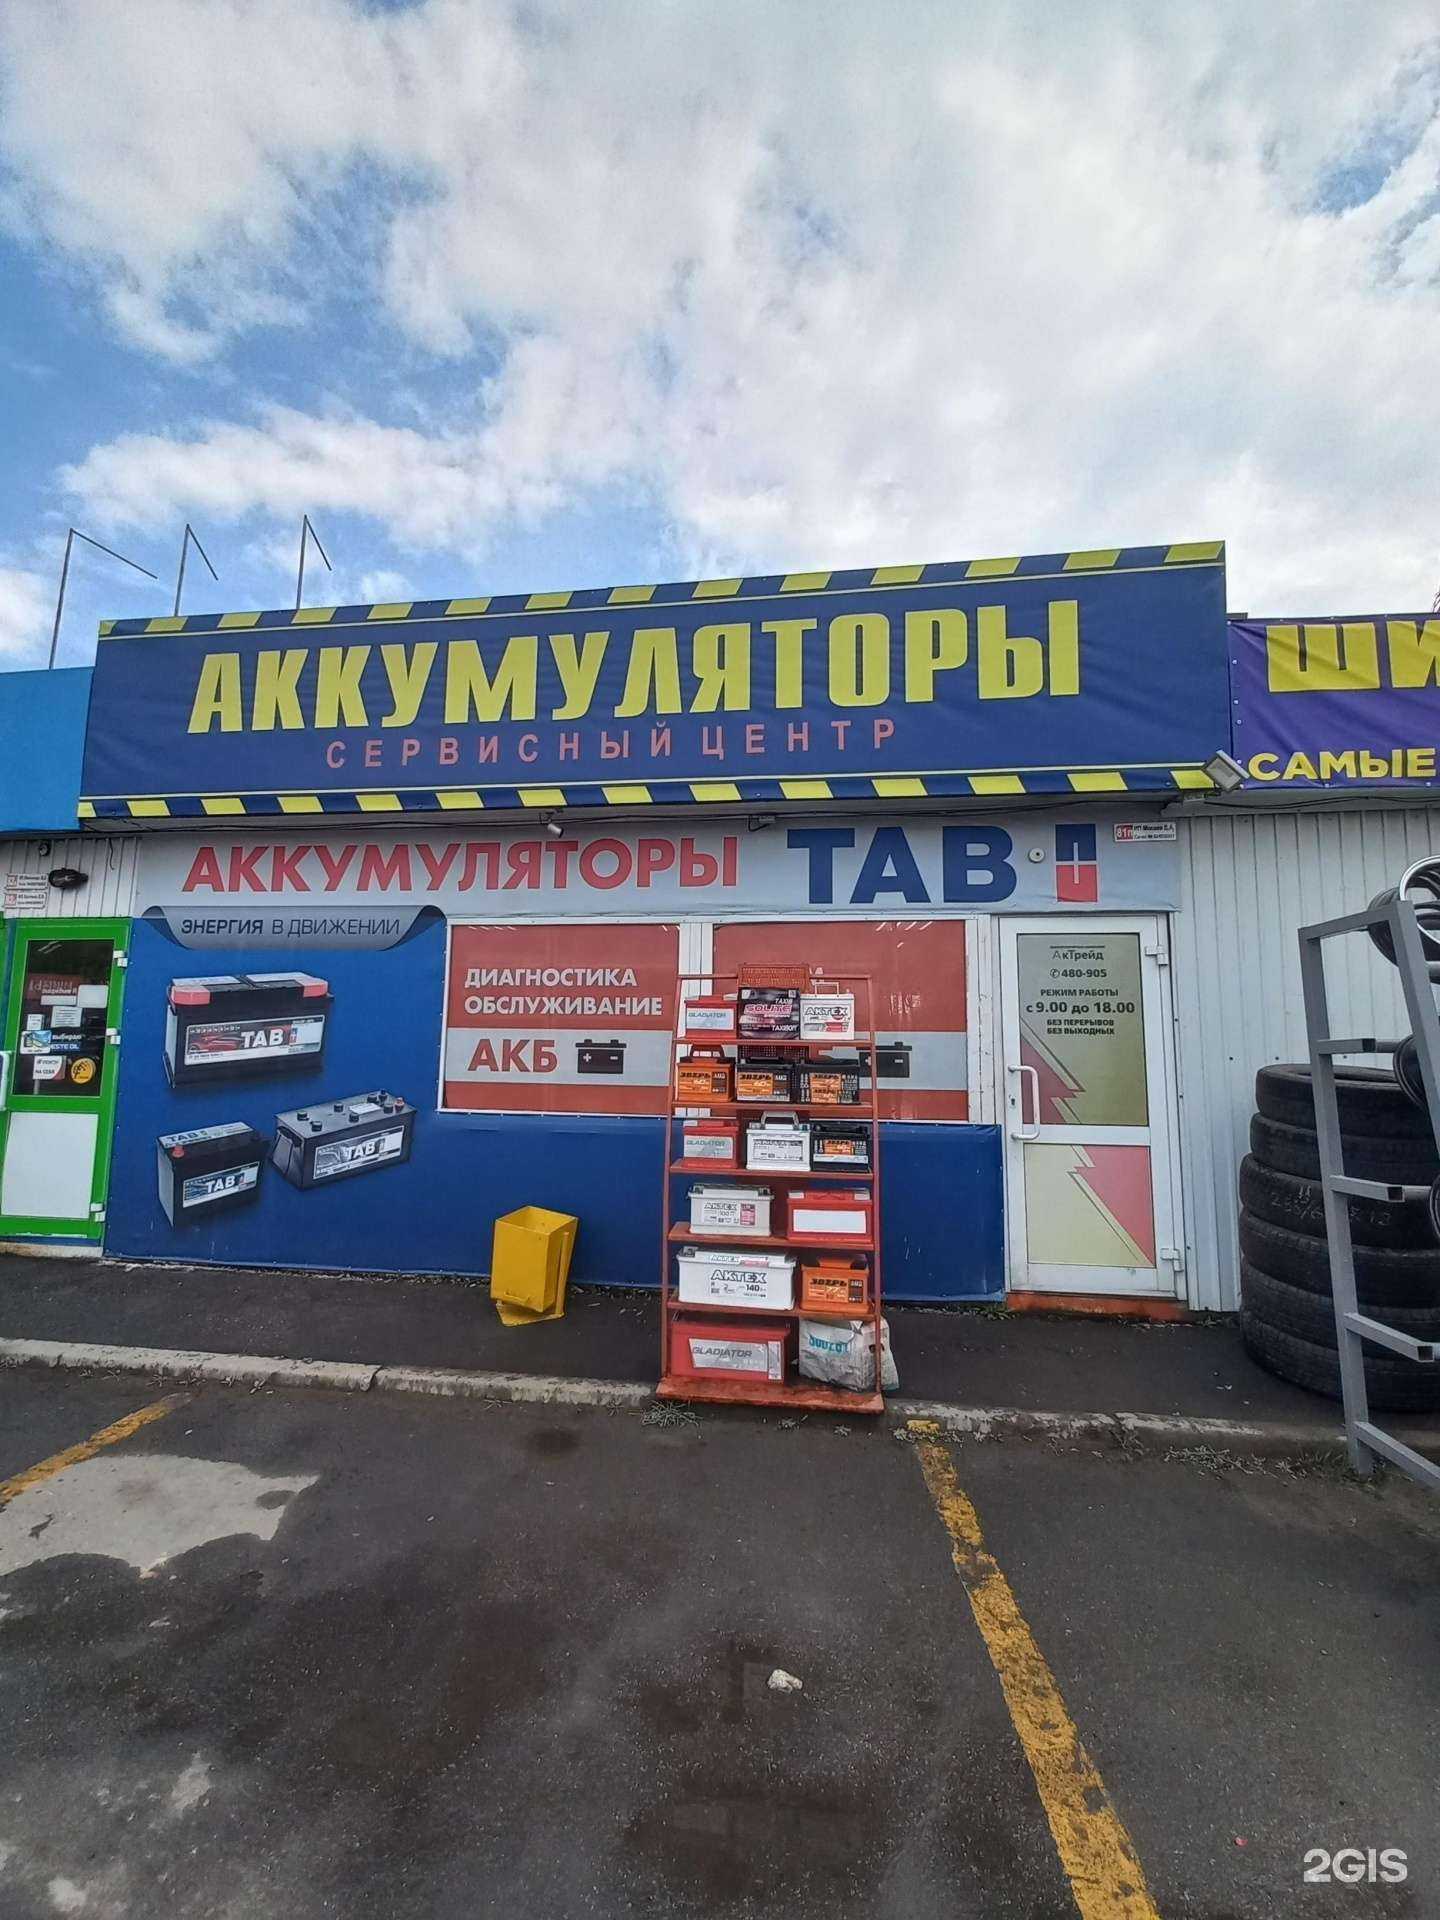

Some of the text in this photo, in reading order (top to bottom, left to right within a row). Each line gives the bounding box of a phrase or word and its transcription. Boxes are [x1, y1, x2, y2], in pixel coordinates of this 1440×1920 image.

[187, 600, 1080, 733] АККУМУЛЯТОРЫ
[326, 719, 895, 769] СЕРВИСНЫЙ ЦЕНТР
[1248, 748, 1436, 781] САМЫЕ
[181, 825, 1017, 904] АККУМУЛЯТОРЫ TAB
[181, 919, 400, 937] ЭНЕРГИЯ В ДВИЖЕНИИ
[1052, 949, 1104, 961] АкТрейд
[465, 968, 638, 988] ДИАГНОСТИКА
[1061, 969, 1107, 978] 480-905
[1040, 989, 1119, 997] РЕЖИМ РАБОТЫ
[464, 996, 662, 1016] ОБСЛУЖИВАНИЕ
[805, 1006, 848, 1017] AKTEX
[1026, 1002, 1135, 1014] с 9.00 до 18.00
[241, 1028, 284, 1048] TAB
[467, 1038, 559, 1073] АКБ
[344, 1141, 376, 1160] TAB
[207, 1175, 236, 1194] TAB
[711, 1269, 767, 1285] AKTEX
[746, 1283, 760, 1293] 140
[693, 1346, 753, 1358] GLADIATOR
